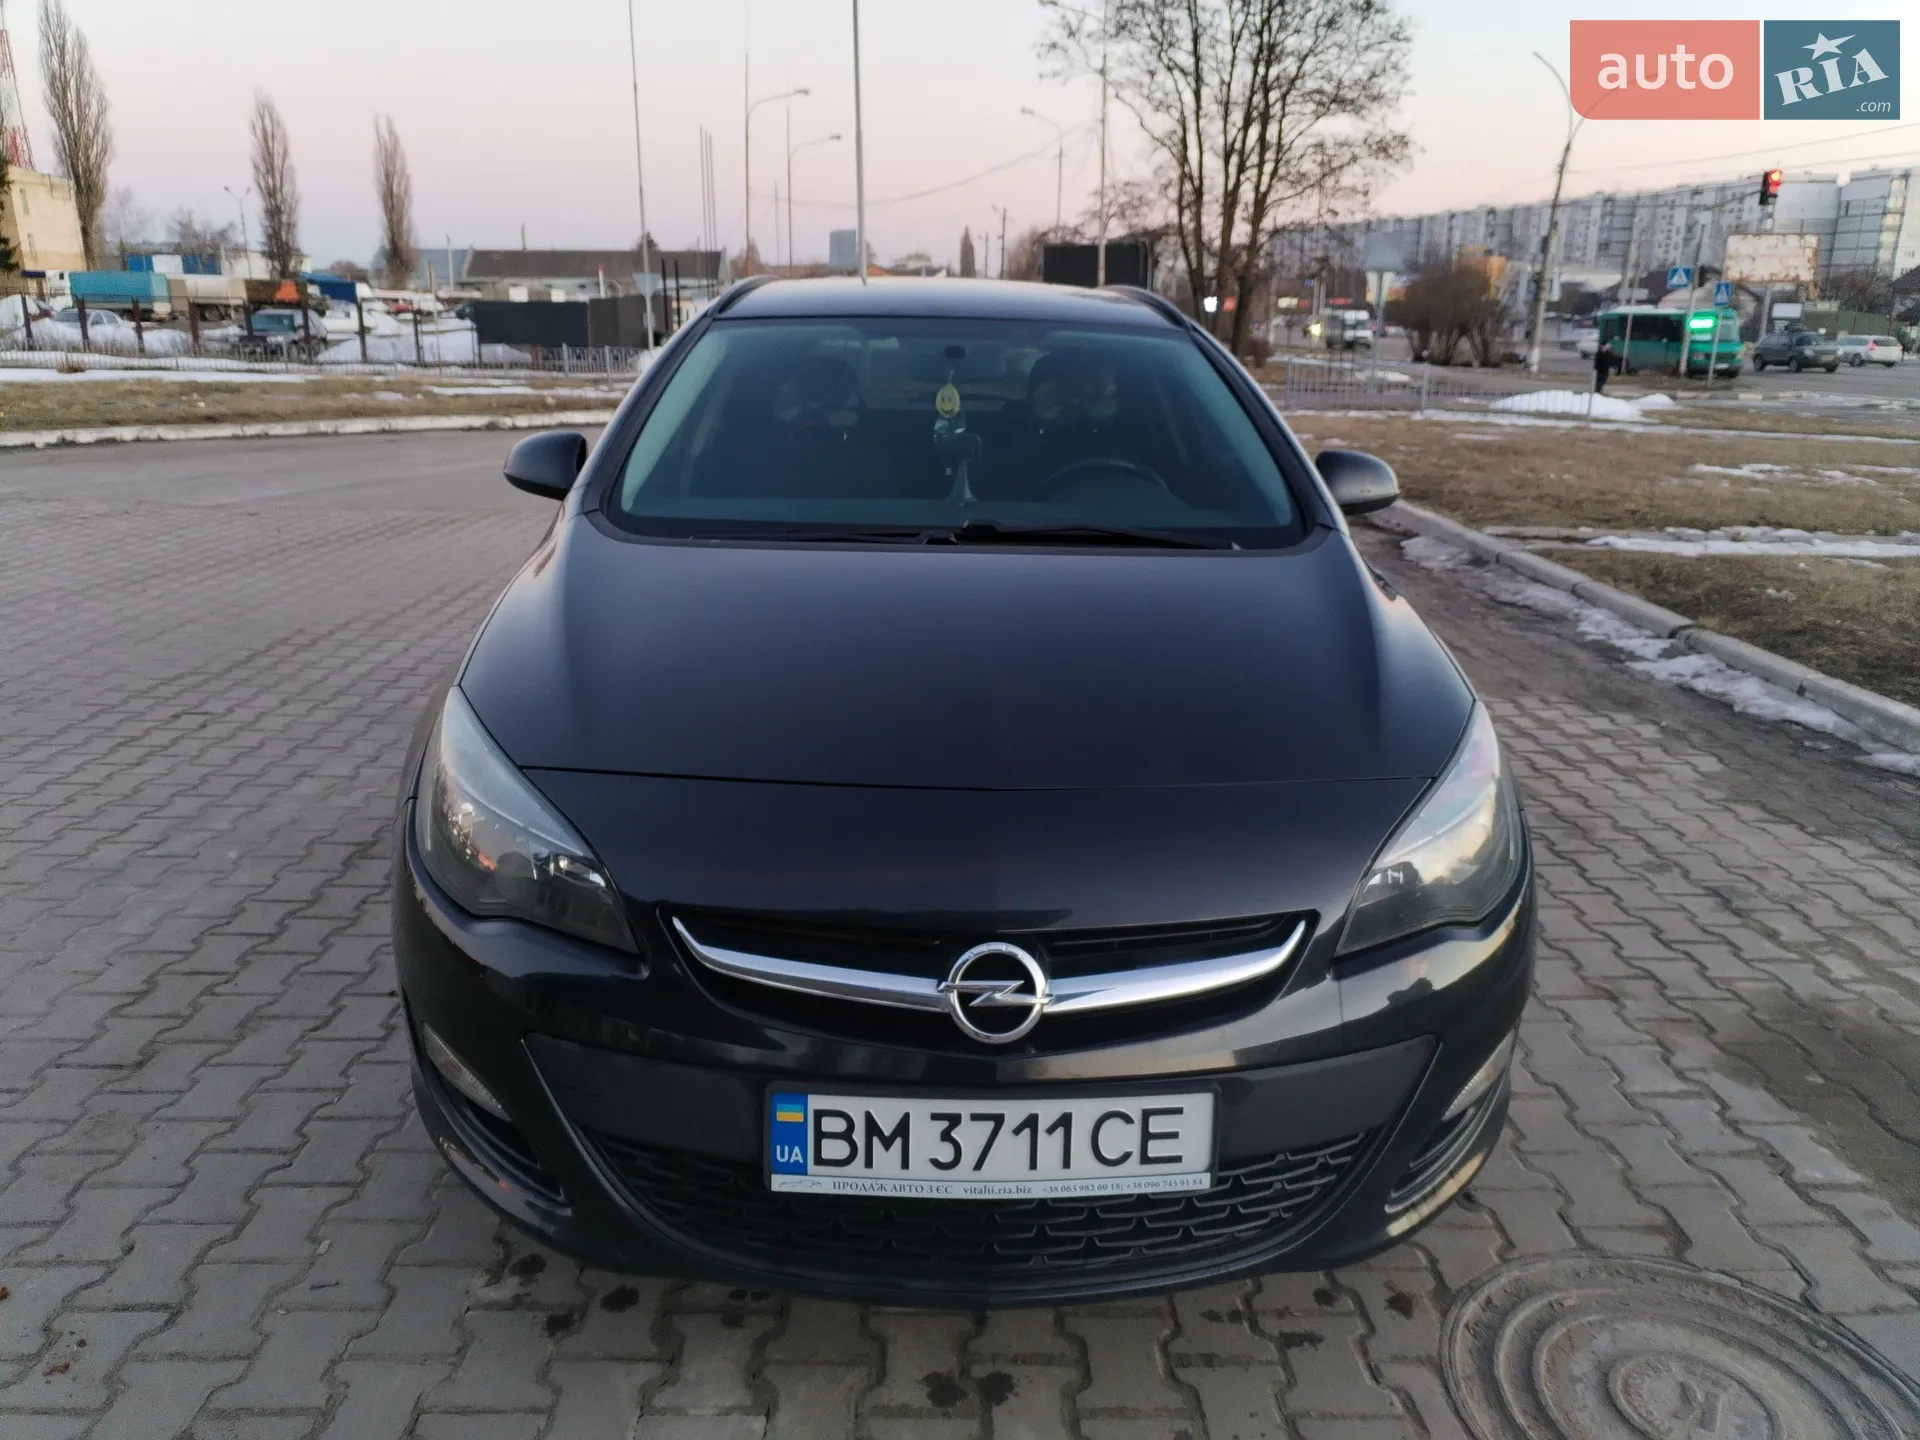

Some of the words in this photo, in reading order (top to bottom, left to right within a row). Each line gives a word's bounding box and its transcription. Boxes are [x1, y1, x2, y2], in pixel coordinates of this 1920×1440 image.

[812, 1108, 911, 1170] BM
[928, 1111, 1073, 1172] 3711
[1090, 1105, 1185, 1168] CE
[776, 1144, 804, 1164] UA
[832, 1180, 888, 1193] ПРОДАЖ
[890, 1183, 924, 1194] АВТО
[963, 1184, 1033, 1196] vitalii.ria.biz
